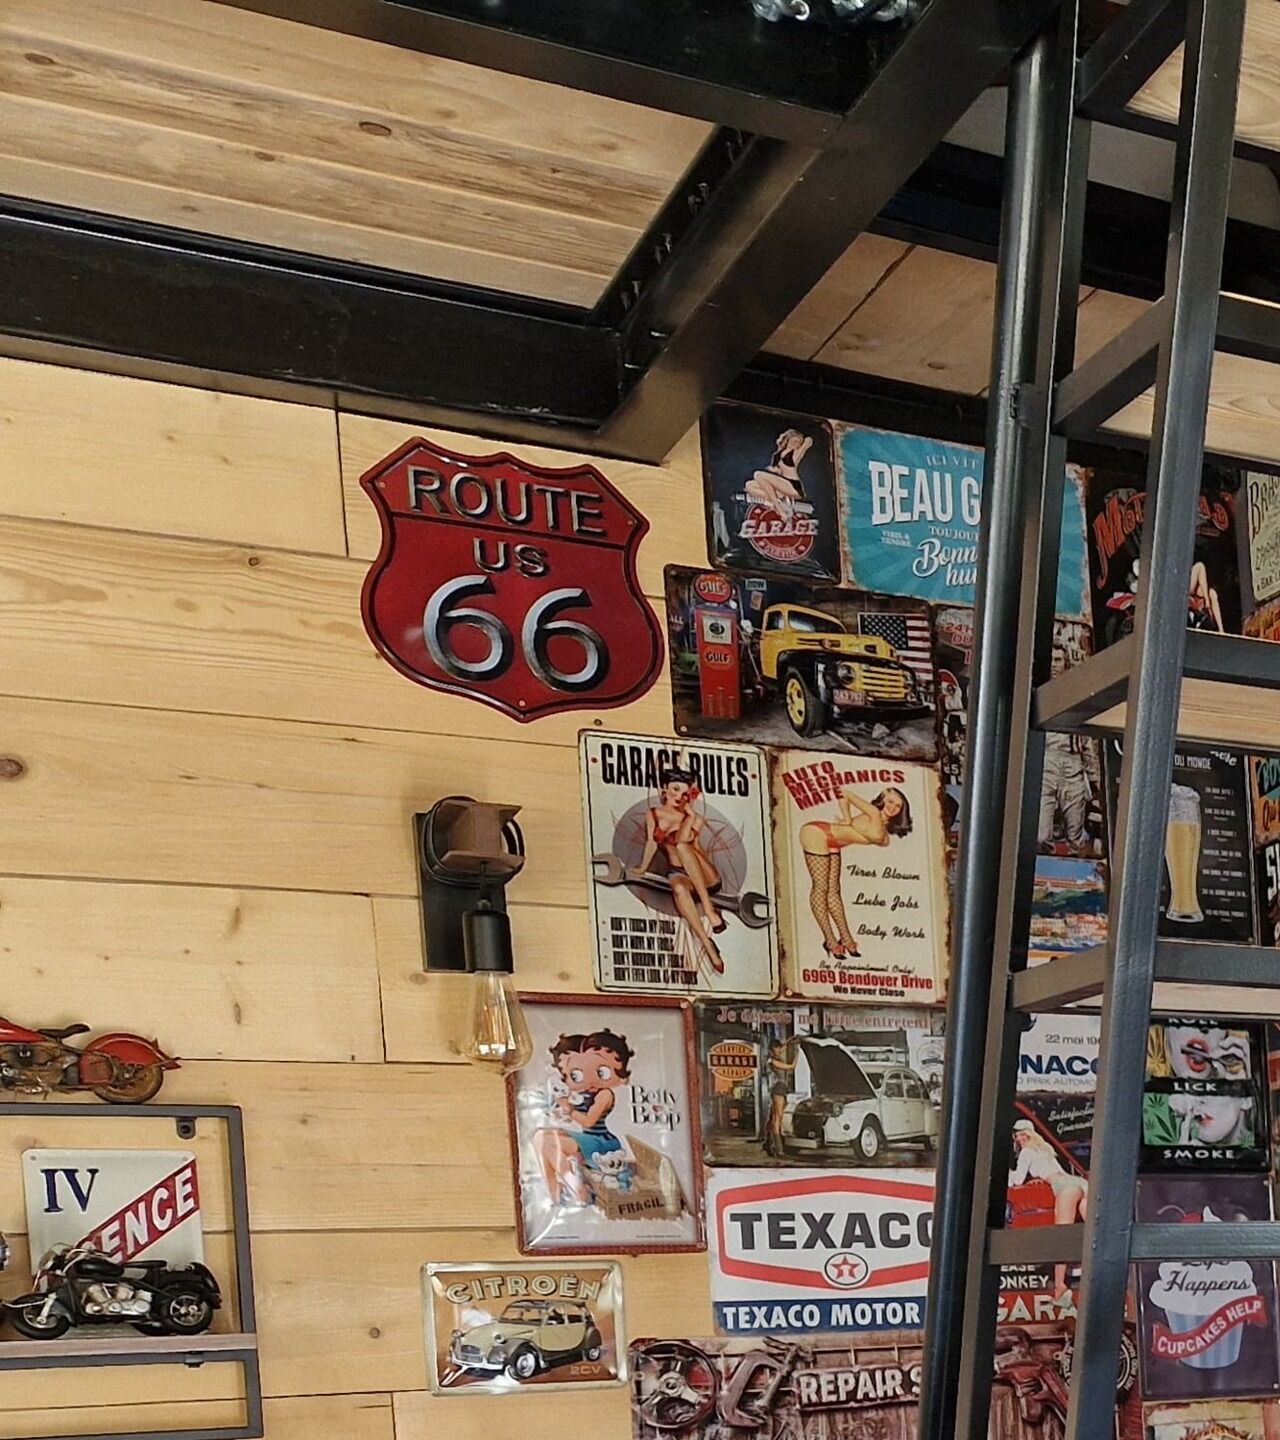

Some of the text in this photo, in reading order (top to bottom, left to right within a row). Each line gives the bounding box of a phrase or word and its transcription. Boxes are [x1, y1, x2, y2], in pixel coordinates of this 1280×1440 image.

[407, 464, 608, 537] ROUTE
[869, 460, 952, 525] BEAU
[738, 518, 820, 539] GARAGE
[473, 537, 546, 577] US
[700, 581, 726, 594] GULF
[422, 574, 610, 694] 66
[706, 652, 730, 664] GULF
[601, 743, 749, 797] GARAGE RULES
[782, 760, 836, 786] AUTO
[1186, 756, 1212, 770] MONDE
[786, 770, 905, 799] MECHANICS
[799, 788, 845, 811] MATE
[847, 864, 920, 882] Tires Blown
[852, 896, 920, 911] Lube Jobs
[857, 924, 926, 940] Body Work
[802, 967, 934, 990] 6969 Bendover Drive
[833, 985, 906, 998] We Never Close
[1045, 1034, 1084, 1045] 22 mai
[711, 1055, 757, 1067] GARAGE
[630, 1084, 678, 1105] Betty
[1173, 1082, 1217, 1093] LICK
[631, 1104, 681, 1132] Boop
[1163, 1149, 1235, 1160] SMOKE
[40, 1168, 99, 1213] IV
[98, 1167, 195, 1264] ENCE
[446, 1273, 601, 1304] CITROËN
[1163, 1270, 1252, 1297] Happens
[722, 1299, 921, 1330] TEXACO MOTOR
[1157, 1299, 1262, 1355] CUPCAKES HELP
[570, 1366, 601, 1376] 2CV
[803, 1367, 903, 1403] REPAIR
